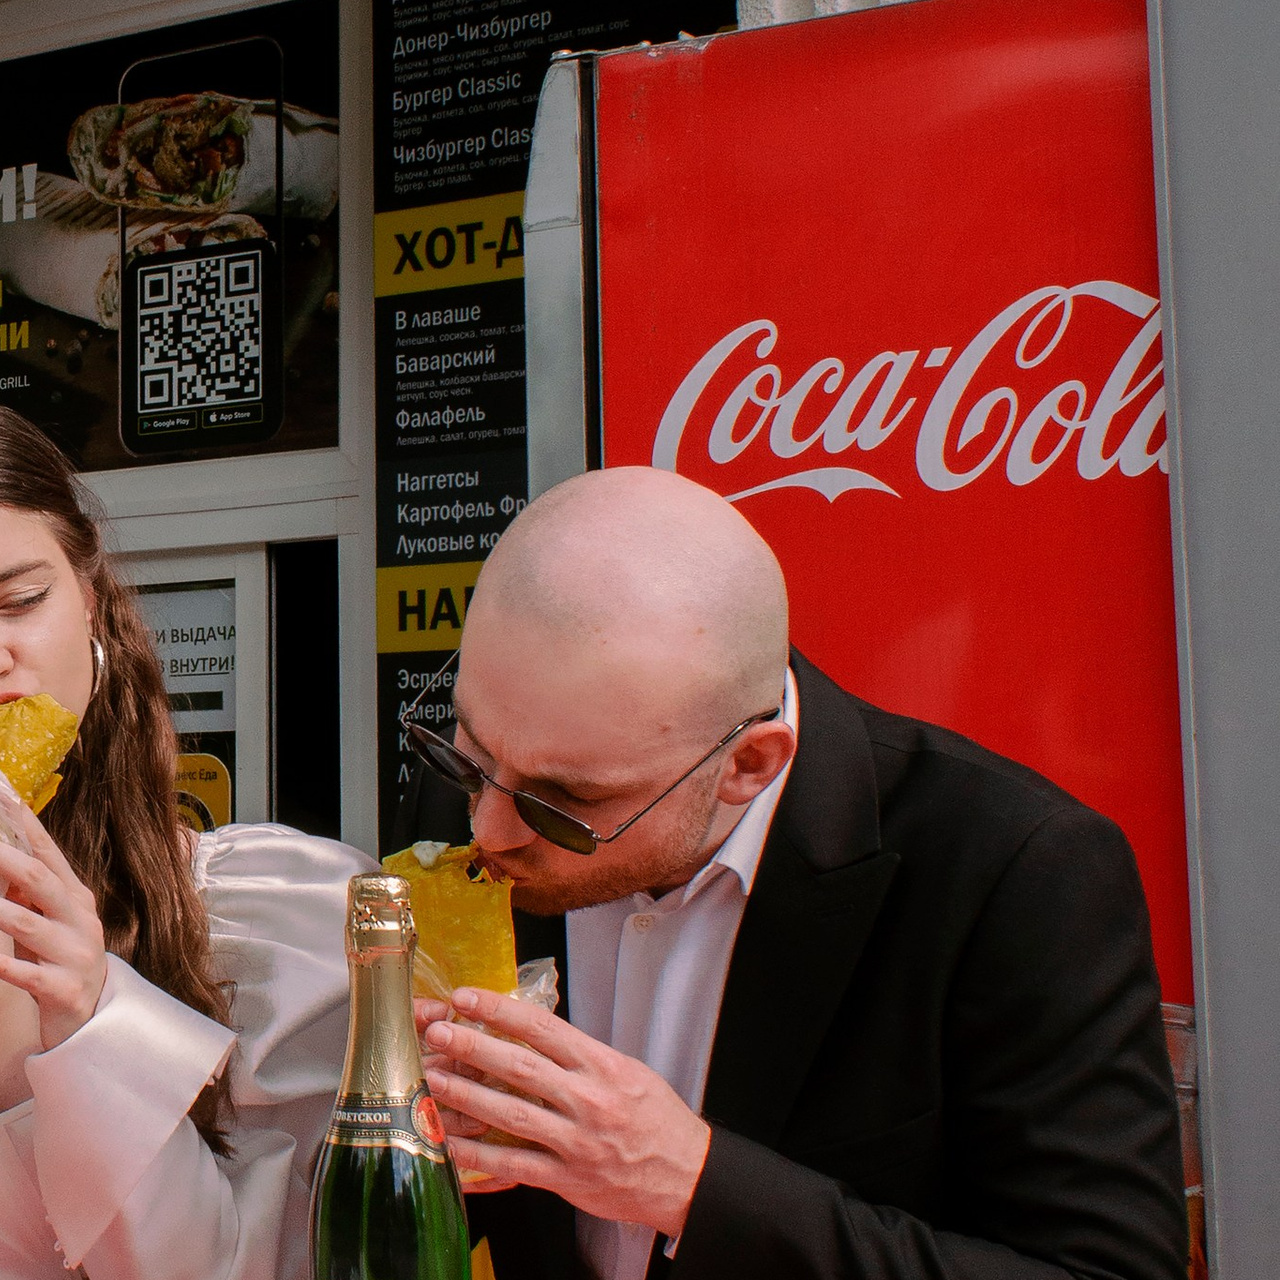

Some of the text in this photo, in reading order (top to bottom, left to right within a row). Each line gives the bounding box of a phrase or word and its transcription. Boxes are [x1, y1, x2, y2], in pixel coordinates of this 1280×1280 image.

[393, 9, 552, 60] Донер-Чизбургер
[392, 70, 522, 113] Бургер Classic
[393, 135, 486, 165] Чизбургер
[395, 304, 481, 331] В лаваше
[395, 343, 496, 374] Баварский
[395, 405, 486, 430] Фалафель
[397, 471, 479, 493] Наггетсы
[397, 494, 527, 527] Картофель Фр
[396, 534, 475, 559] Луковые
[171, 625, 236, 645] ВЫДАЧА
[170, 655, 236, 674] ВНУТРИ!
[199, 768, 218, 781] Еда
